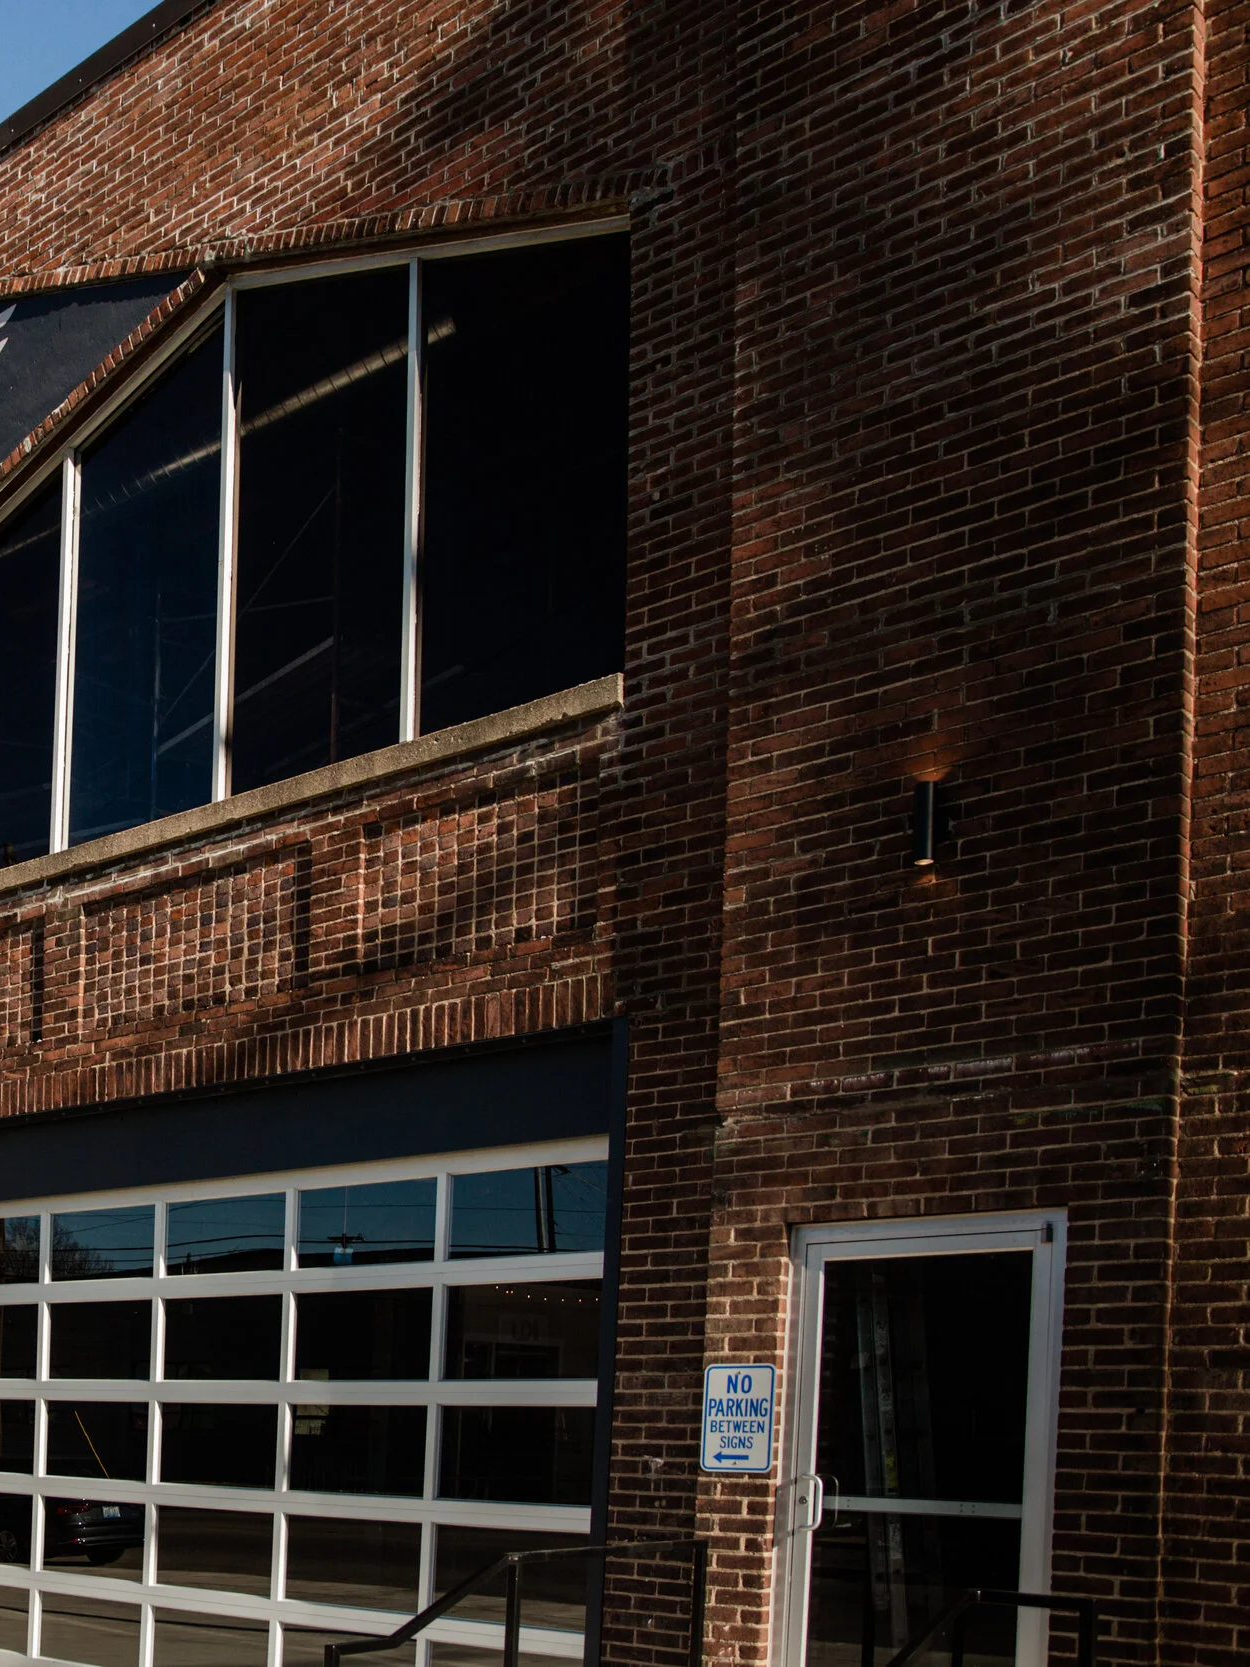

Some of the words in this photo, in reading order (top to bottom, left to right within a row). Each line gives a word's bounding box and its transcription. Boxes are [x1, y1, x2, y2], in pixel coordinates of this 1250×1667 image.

[726, 1374, 752, 1394] NO
[708, 1398, 768, 1417] PARKING
[710, 1420, 765, 1433] BETWEEN
[719, 1436, 754, 1449] SIGNS
